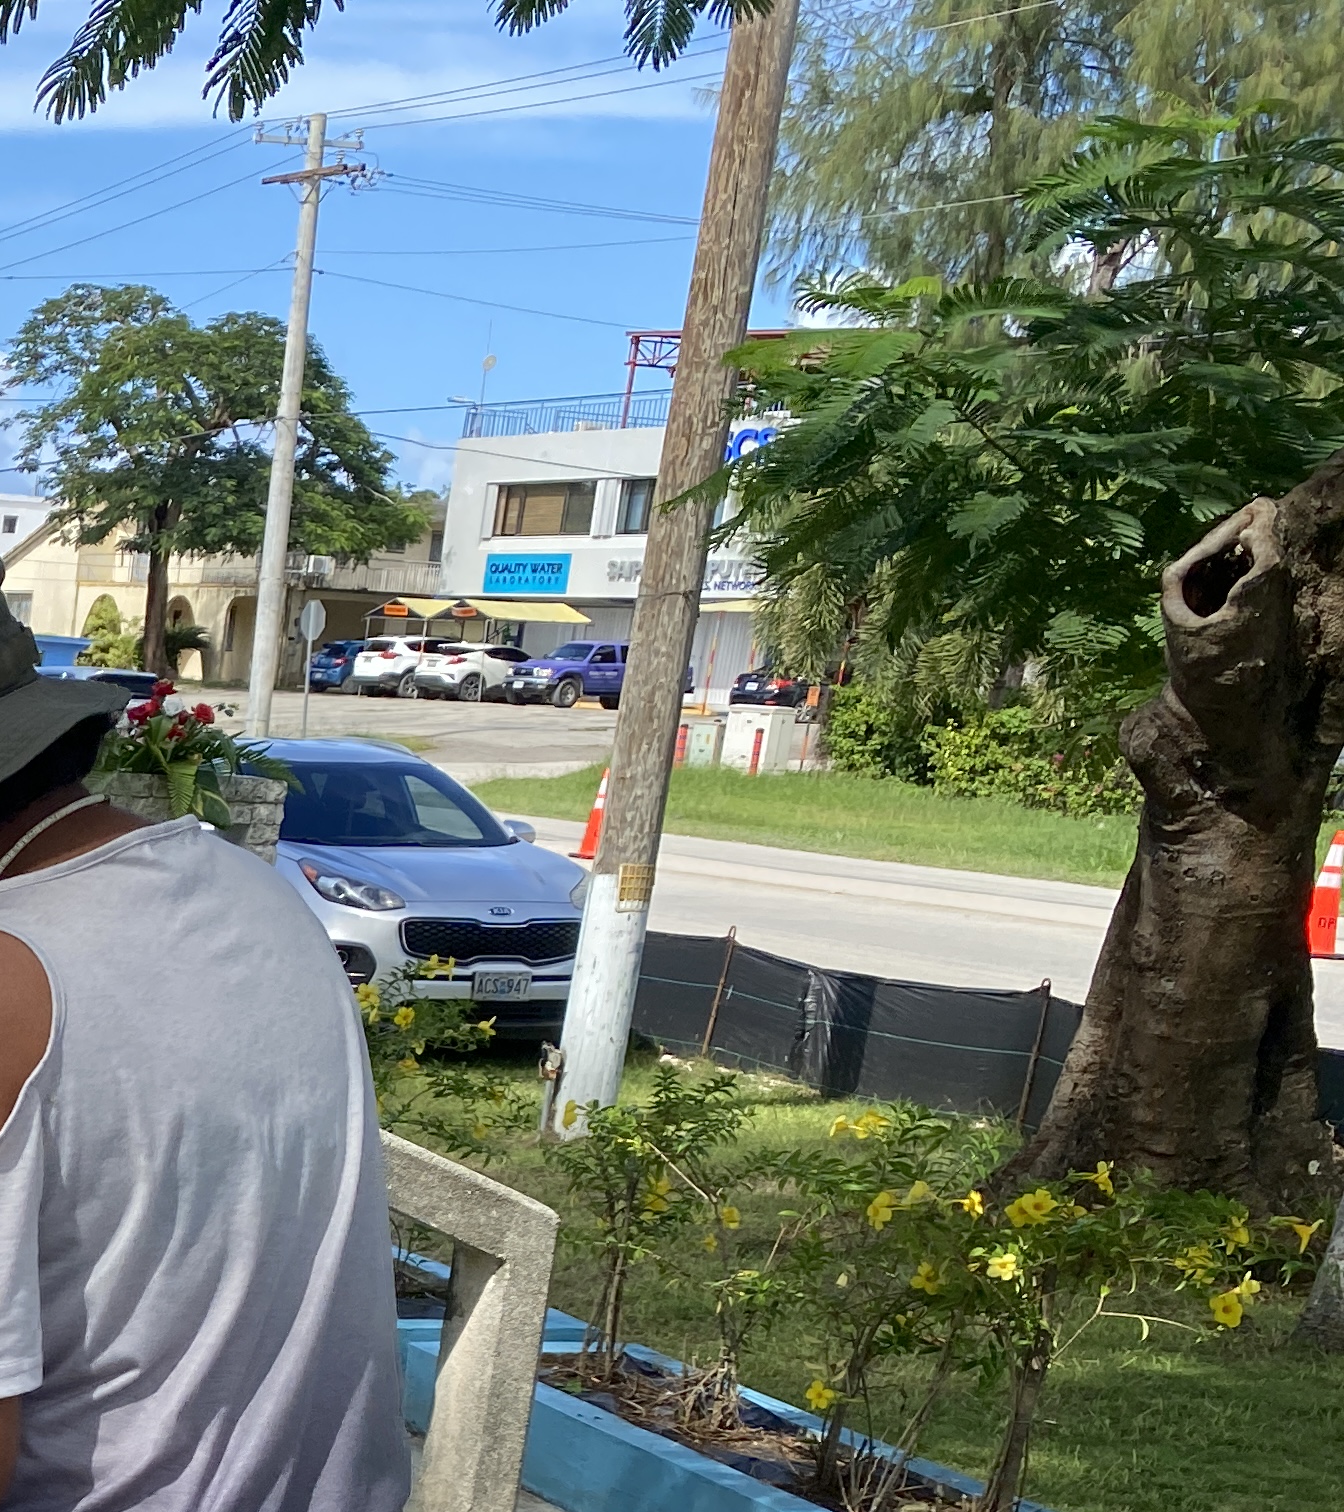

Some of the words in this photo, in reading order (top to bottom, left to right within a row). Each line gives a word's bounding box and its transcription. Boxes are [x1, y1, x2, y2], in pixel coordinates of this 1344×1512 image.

[489, 562, 528, 575] QUALITY
[530, 562, 563, 575] WATER
[489, 575, 561, 585] LABORATORY
[476, 978, 499, 994] ACS
[507, 978, 529, 994] 947
